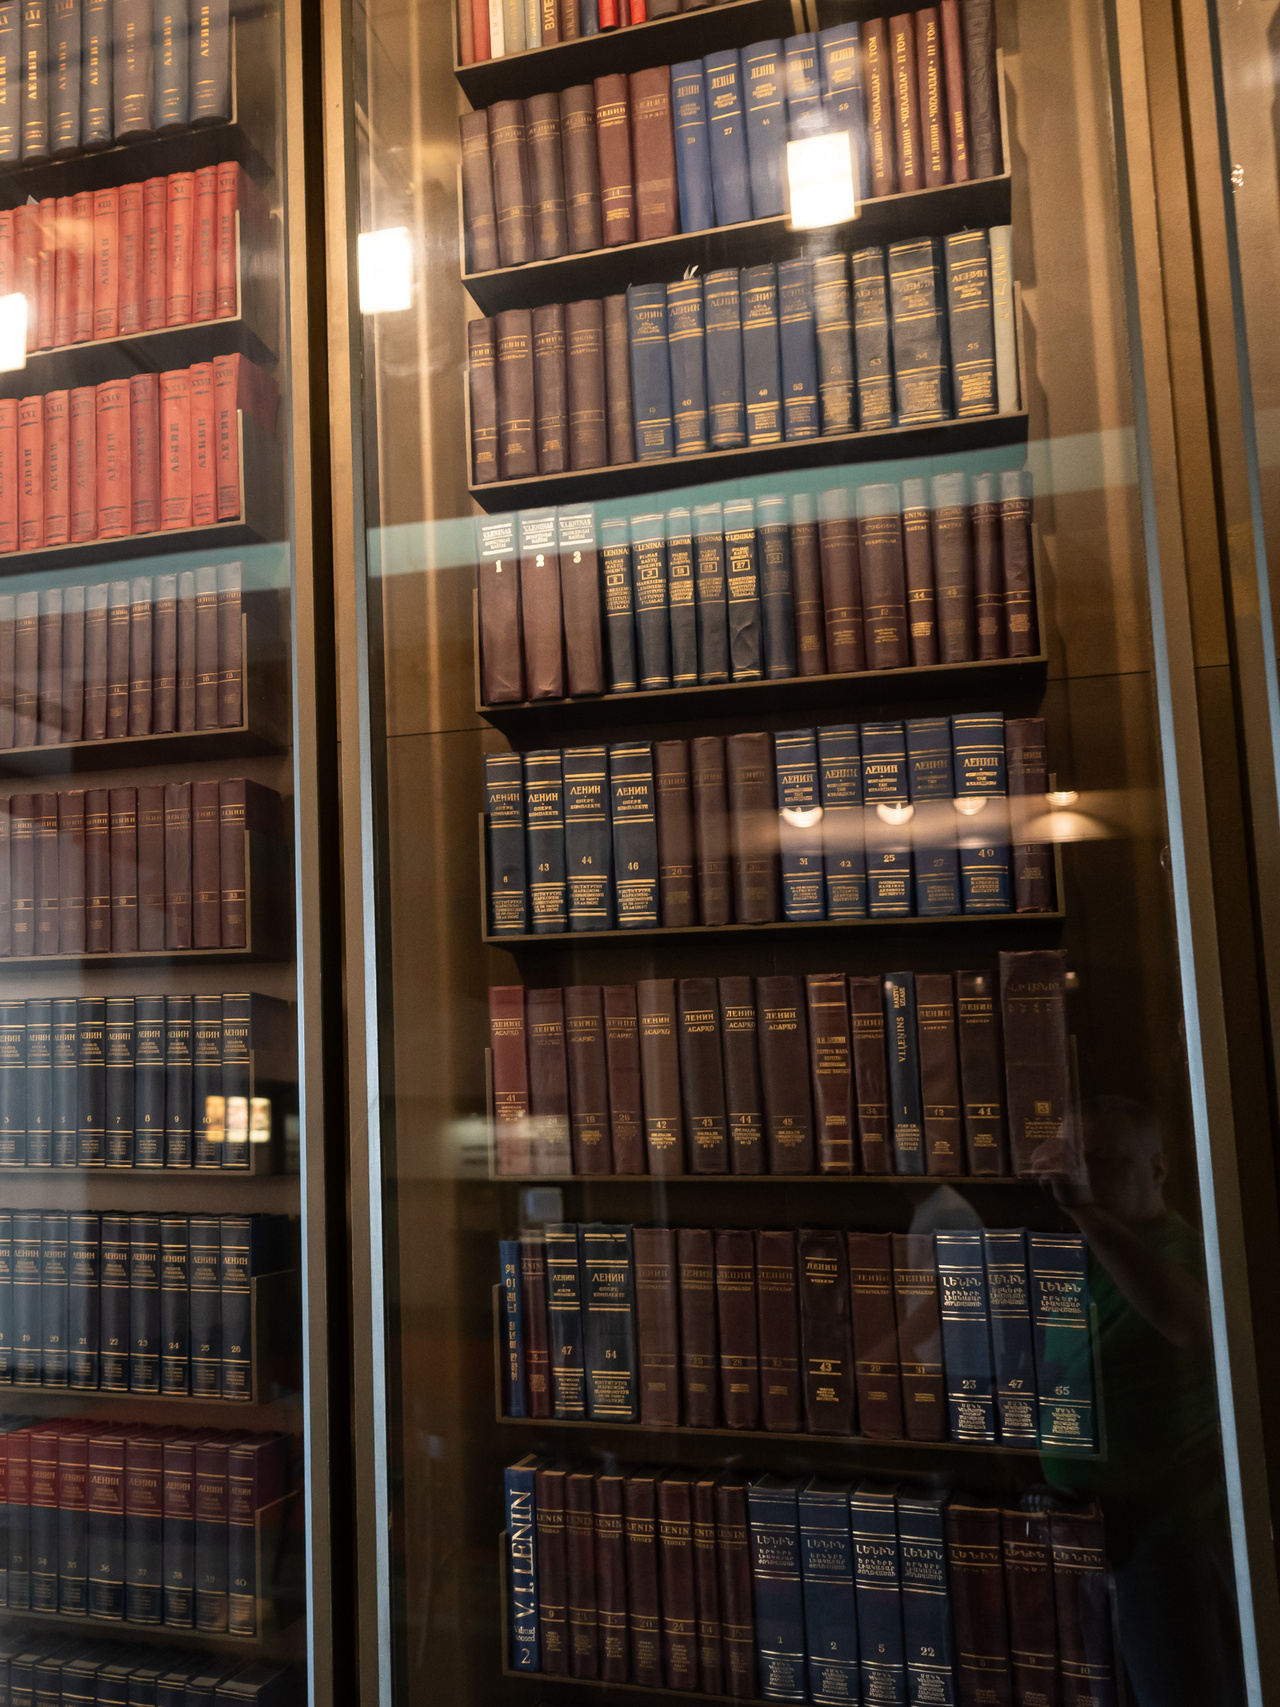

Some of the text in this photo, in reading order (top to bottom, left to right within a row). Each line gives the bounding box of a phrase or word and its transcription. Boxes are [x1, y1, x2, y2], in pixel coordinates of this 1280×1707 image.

[927, 22, 935, 41] ТОМ
[868, 36, 878, 57] ТОМ
[896, 33, 905, 53] ТОМ
[536, 554, 545, 567] 2
[573, 551, 582, 563] 3
[495, 560, 502, 573] 1
[964, 757, 999, 767] ЛЕНИН
[825, 769, 857, 779] ЛЕНИН
[865, 765, 898, 775] ЛЕНИН
[782, 774, 813, 784] ЛЕНИН
[570, 785, 601, 795] ЛЕНИН
[616, 786, 648, 796] ЛЕНИН
[490, 793, 520, 803] ЛЕНИН
[528, 793, 558, 803] ЛЕНИН
[978, 849, 994, 858] 49
[581, 856, 592, 864] 44
[883, 855, 895, 863] 25
[538, 863, 550, 872] 43
[627, 862, 639, 870] 46
[961, 1003, 992, 1011] ЛЕНИН
[685, 1013, 714, 1022] ЛЕНИН
[79, 1031, 102, 1040] ЛЕНИН
[108, 1032, 131, 1040] ЛЕНИН
[138, 1030, 160, 1038] ЛЕНИН
[167, 1030, 189, 1039] ЛЕНИН
[195, 1031, 220, 1039] ЛЕНИН
[223, 1029, 248, 1037] ЛЕНИН
[978, 1108, 992, 1116] 41
[656, 1121, 667, 1129] 42
[701, 1119, 713, 1127] 43
[104, 1252, 127, 1260] ЛЕНИН
[132, 1253, 156, 1261] ЛЕНИН
[163, 1255, 185, 1263] ЛЕНИН
[192, 1256, 217, 1264] ЛЕНИН
[223, 1256, 248, 1265] ЛЕНИН
[806, 1262, 838, 1271] ЛЕНИН
[592, 1273, 624, 1282] ЛЕНИН
[562, 1346, 572, 1355] 47
[605, 1350, 617, 1359] 54
[820, 1363, 832, 1372] 43
[962, 1380, 976, 1389] 23
[1008, 1380, 1023, 1388] 47
[92, 1475, 119, 1485] ЛЕНИН
[536, 1513, 563, 1523] LENIN
[627, 1523, 655, 1532] LENIN
[660, 1525, 689, 1535] LENIN
[509, 1489, 534, 1576] LENIN
[514, 1601, 535, 1619] V.
[548, 1610, 554, 1619] 9
[830, 1641, 837, 1650] 2
[878, 1643, 885, 1652] 5
[521, 1648, 531, 1664] 2
[920, 1646, 935, 1657] 22
